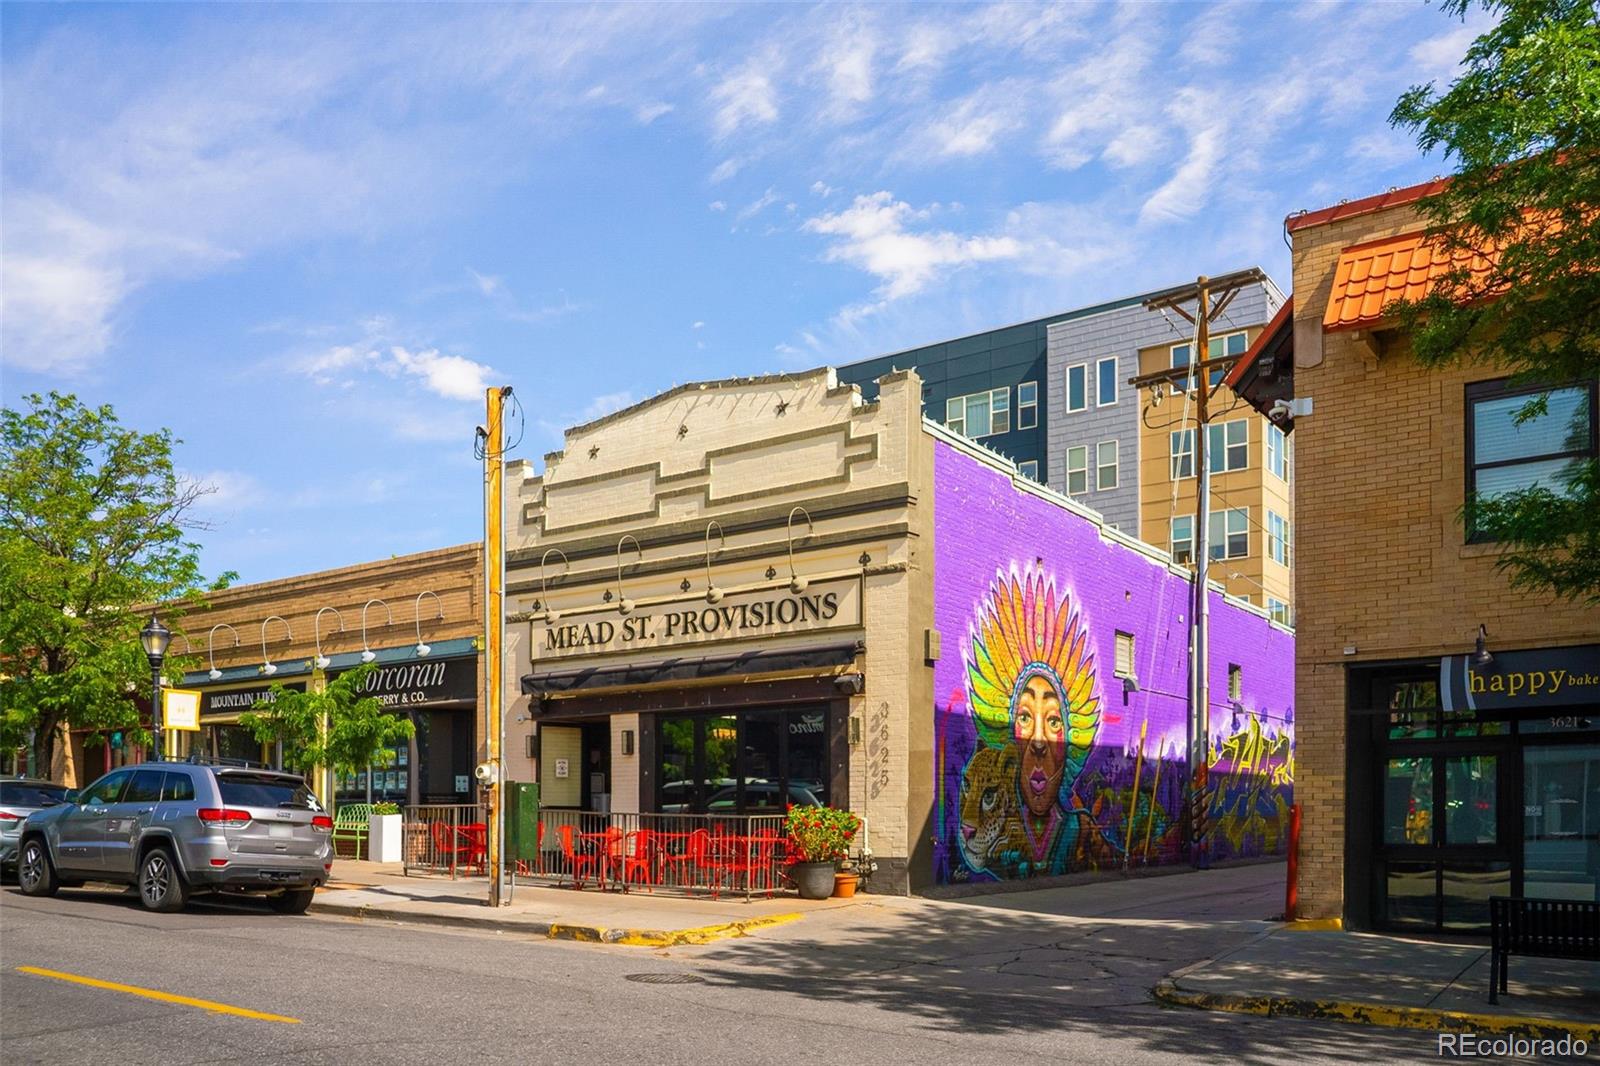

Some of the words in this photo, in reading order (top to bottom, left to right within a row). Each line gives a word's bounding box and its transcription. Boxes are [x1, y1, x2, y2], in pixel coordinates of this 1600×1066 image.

[545, 621, 614, 650] MEAD
[622, 614, 656, 641] ST.
[664, 592, 838, 637] PROVISIONS
[1468, 669, 1567, 697] happy
[210, 692, 254, 709] MOUNTAIN
[374, 693, 400, 705] ERRY
[401, 692, 409, 704] &
[411, 691, 428, 703] CO.
